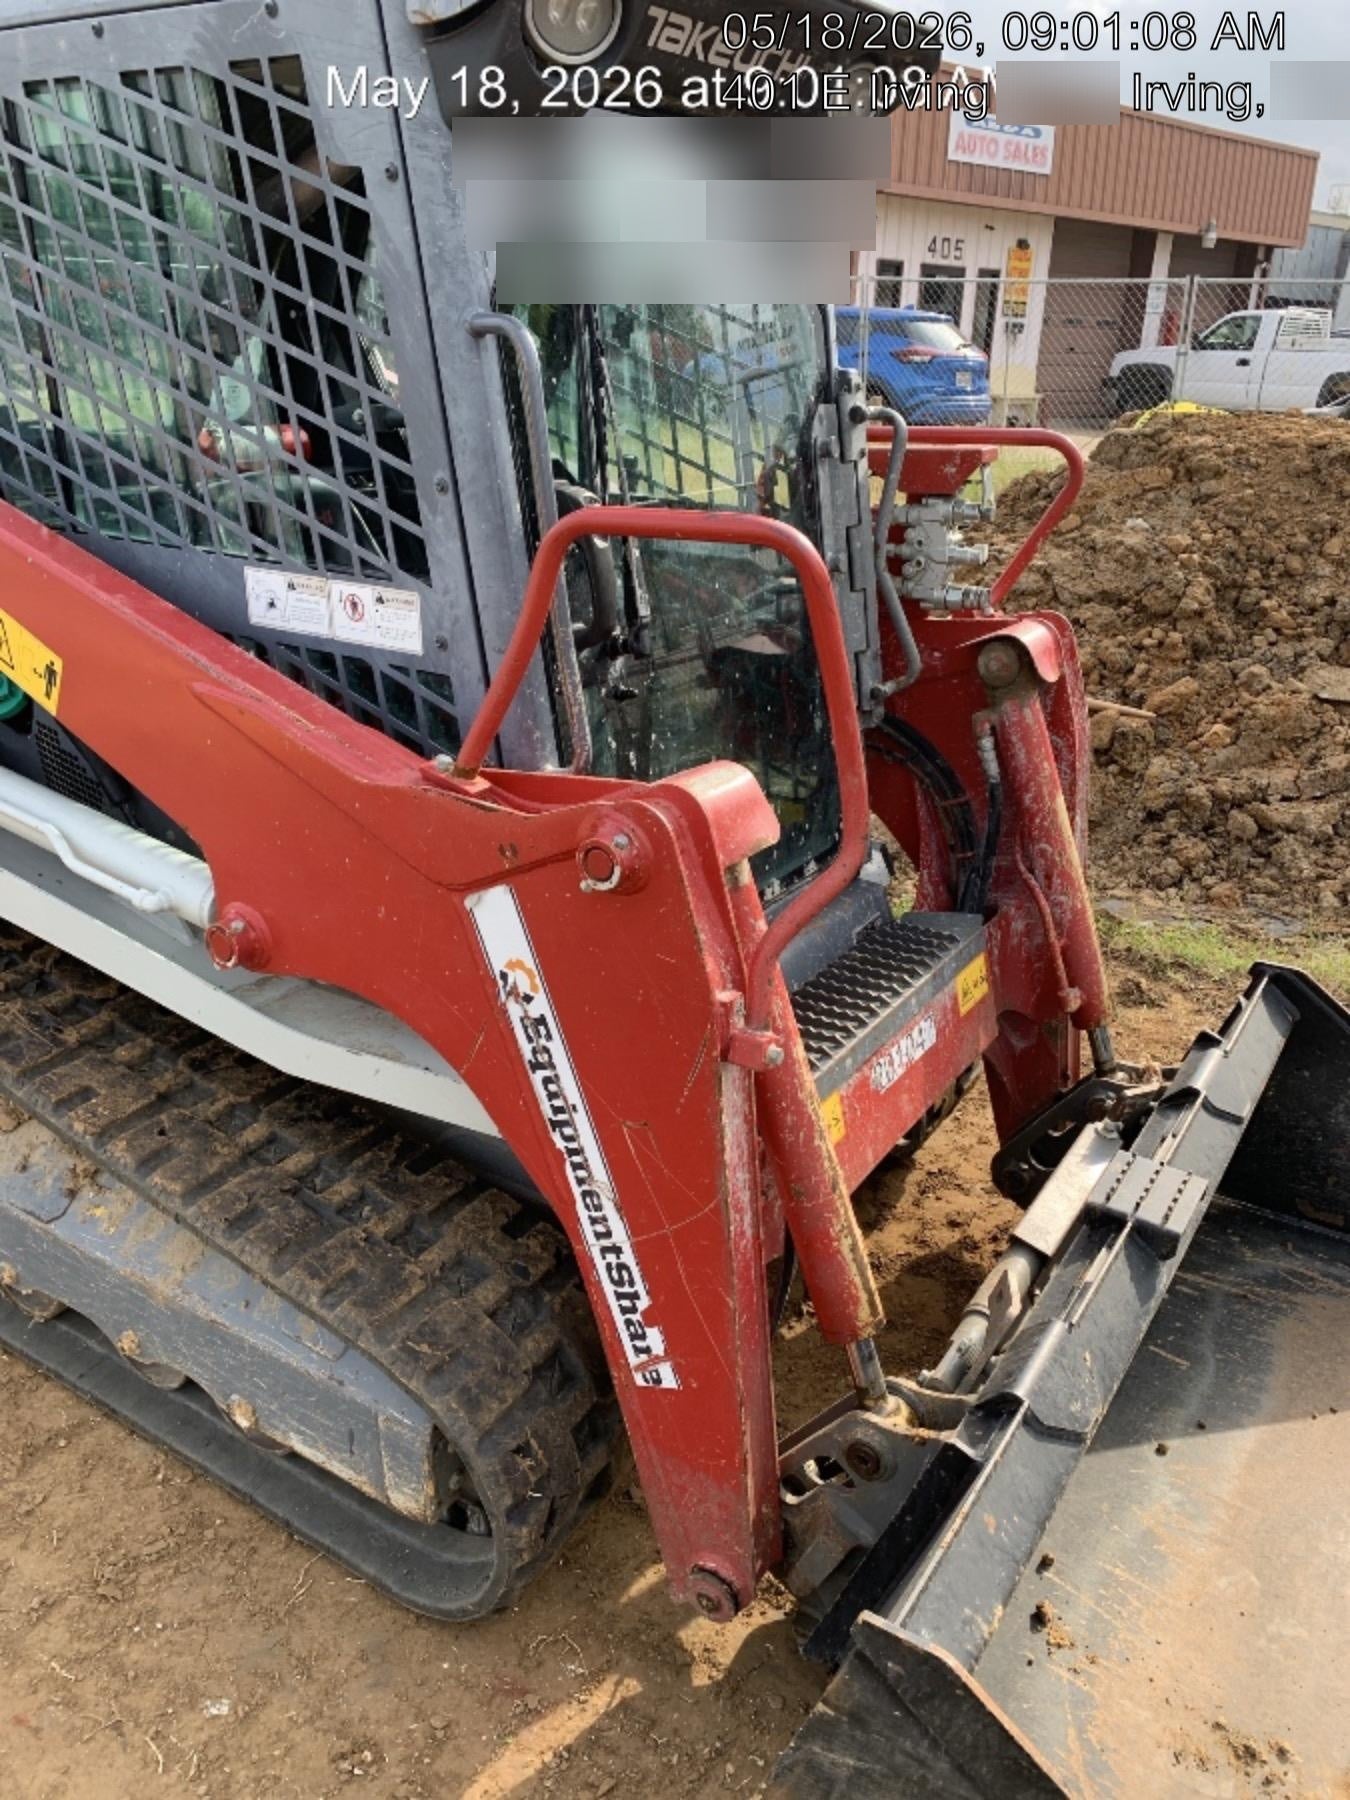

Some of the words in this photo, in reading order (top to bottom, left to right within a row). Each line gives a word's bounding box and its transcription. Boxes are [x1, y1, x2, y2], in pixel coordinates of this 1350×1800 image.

[954, 130, 998, 159] AUTO
[1003, 139, 1049, 166] SALES
[927, 235, 965, 261] 405
